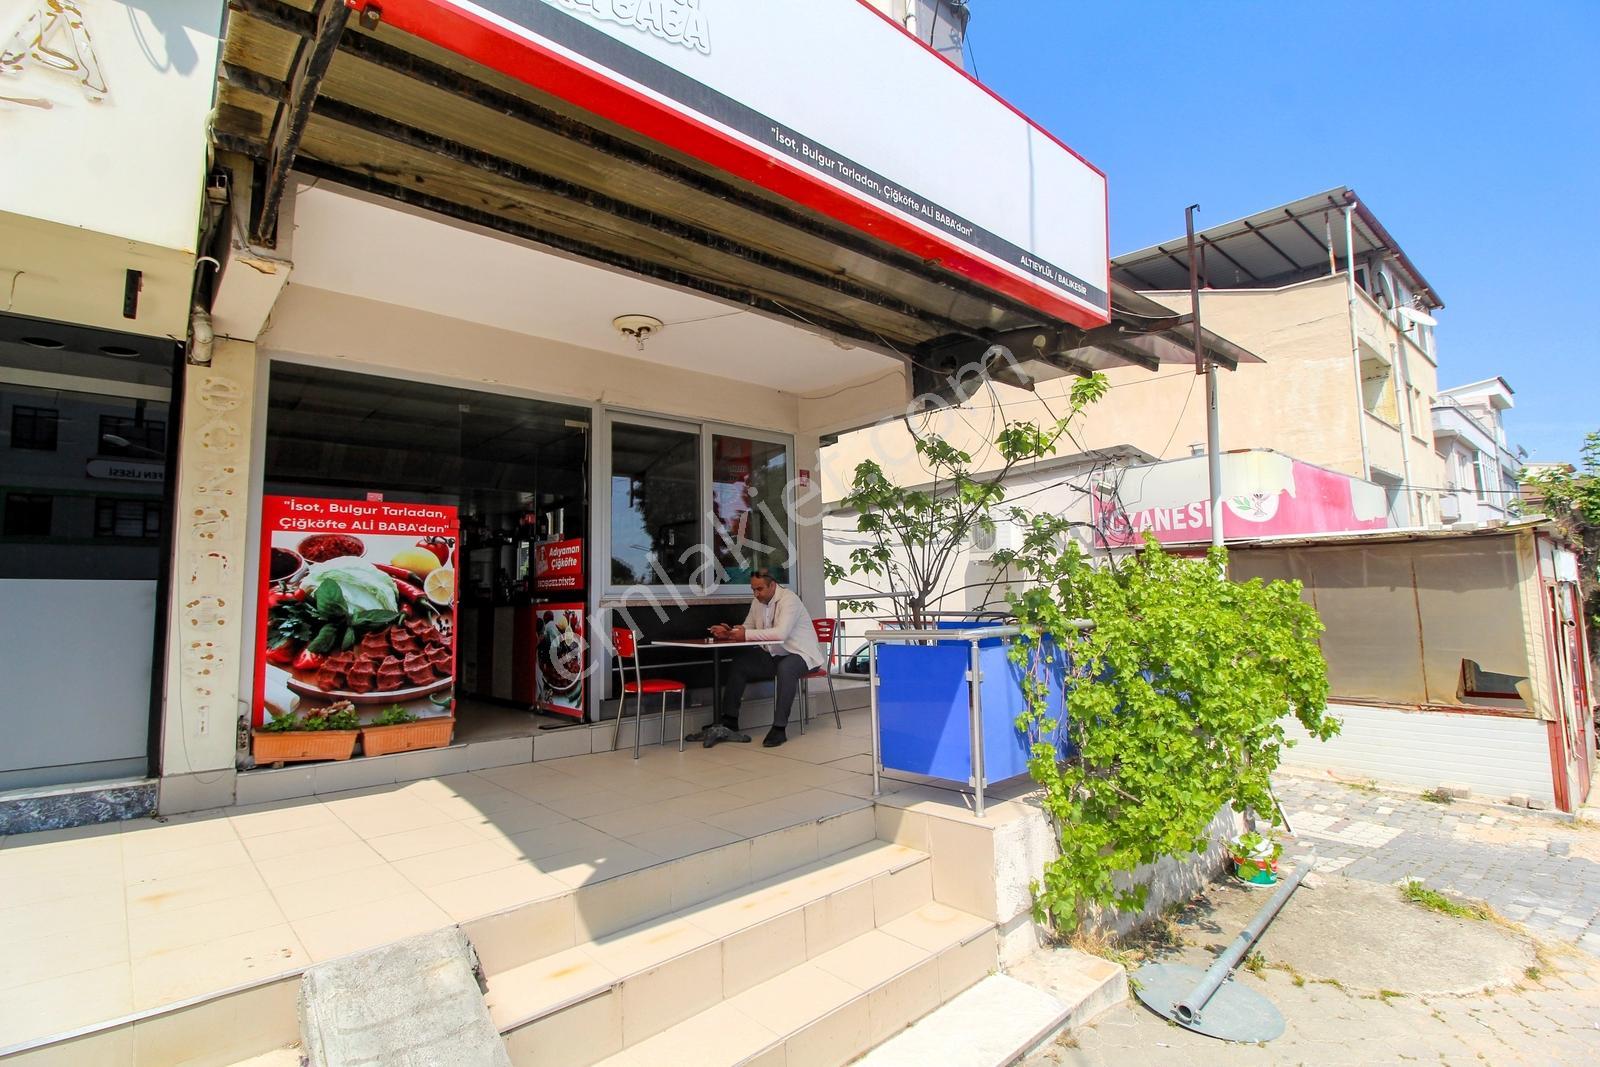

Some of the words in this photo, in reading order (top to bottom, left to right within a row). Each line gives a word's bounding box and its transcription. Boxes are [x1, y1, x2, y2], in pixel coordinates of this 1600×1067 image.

[802, 143, 835, 168] Bulgur
[837, 161, 881, 194] Tarladan,
[883, 185, 920, 211] Çiğköfte
[921, 203, 934, 218] ALİ
[283, 499, 324, 513] "İsot,
[329, 503, 378, 516] Bulgur
[382, 506, 447, 519] Tarladan,
[279, 517, 347, 530] Çiğköfte
[351, 520, 374, 531] ALİ
[378, 522, 450, 533] BABA'dan"
[551, 557, 577, 570] Çiğköfte
